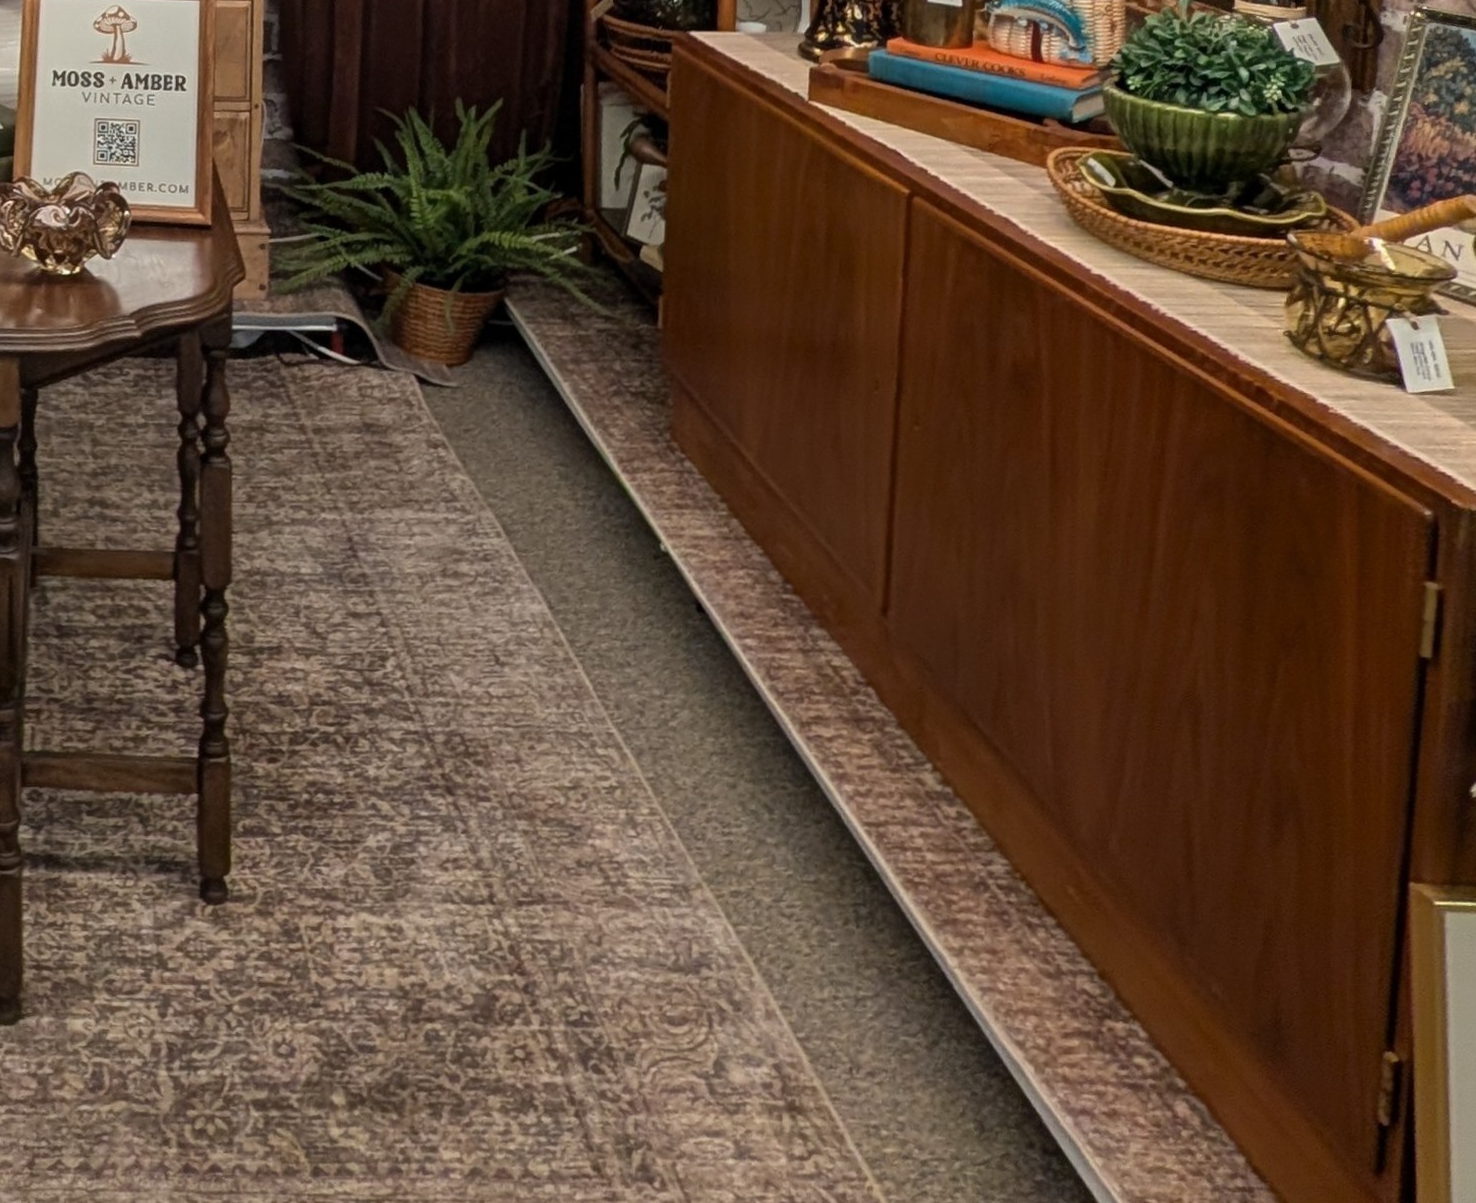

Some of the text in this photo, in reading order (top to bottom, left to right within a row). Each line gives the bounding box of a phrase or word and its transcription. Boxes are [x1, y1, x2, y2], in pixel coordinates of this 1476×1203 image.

[935, 52, 980, 68] CLEVER
[983, 61, 1026, 77] COOKS
[52, 70, 105, 88] MOSS
[121, 73, 187, 91] AMBER
[82, 91, 156, 107] VINTAGE
